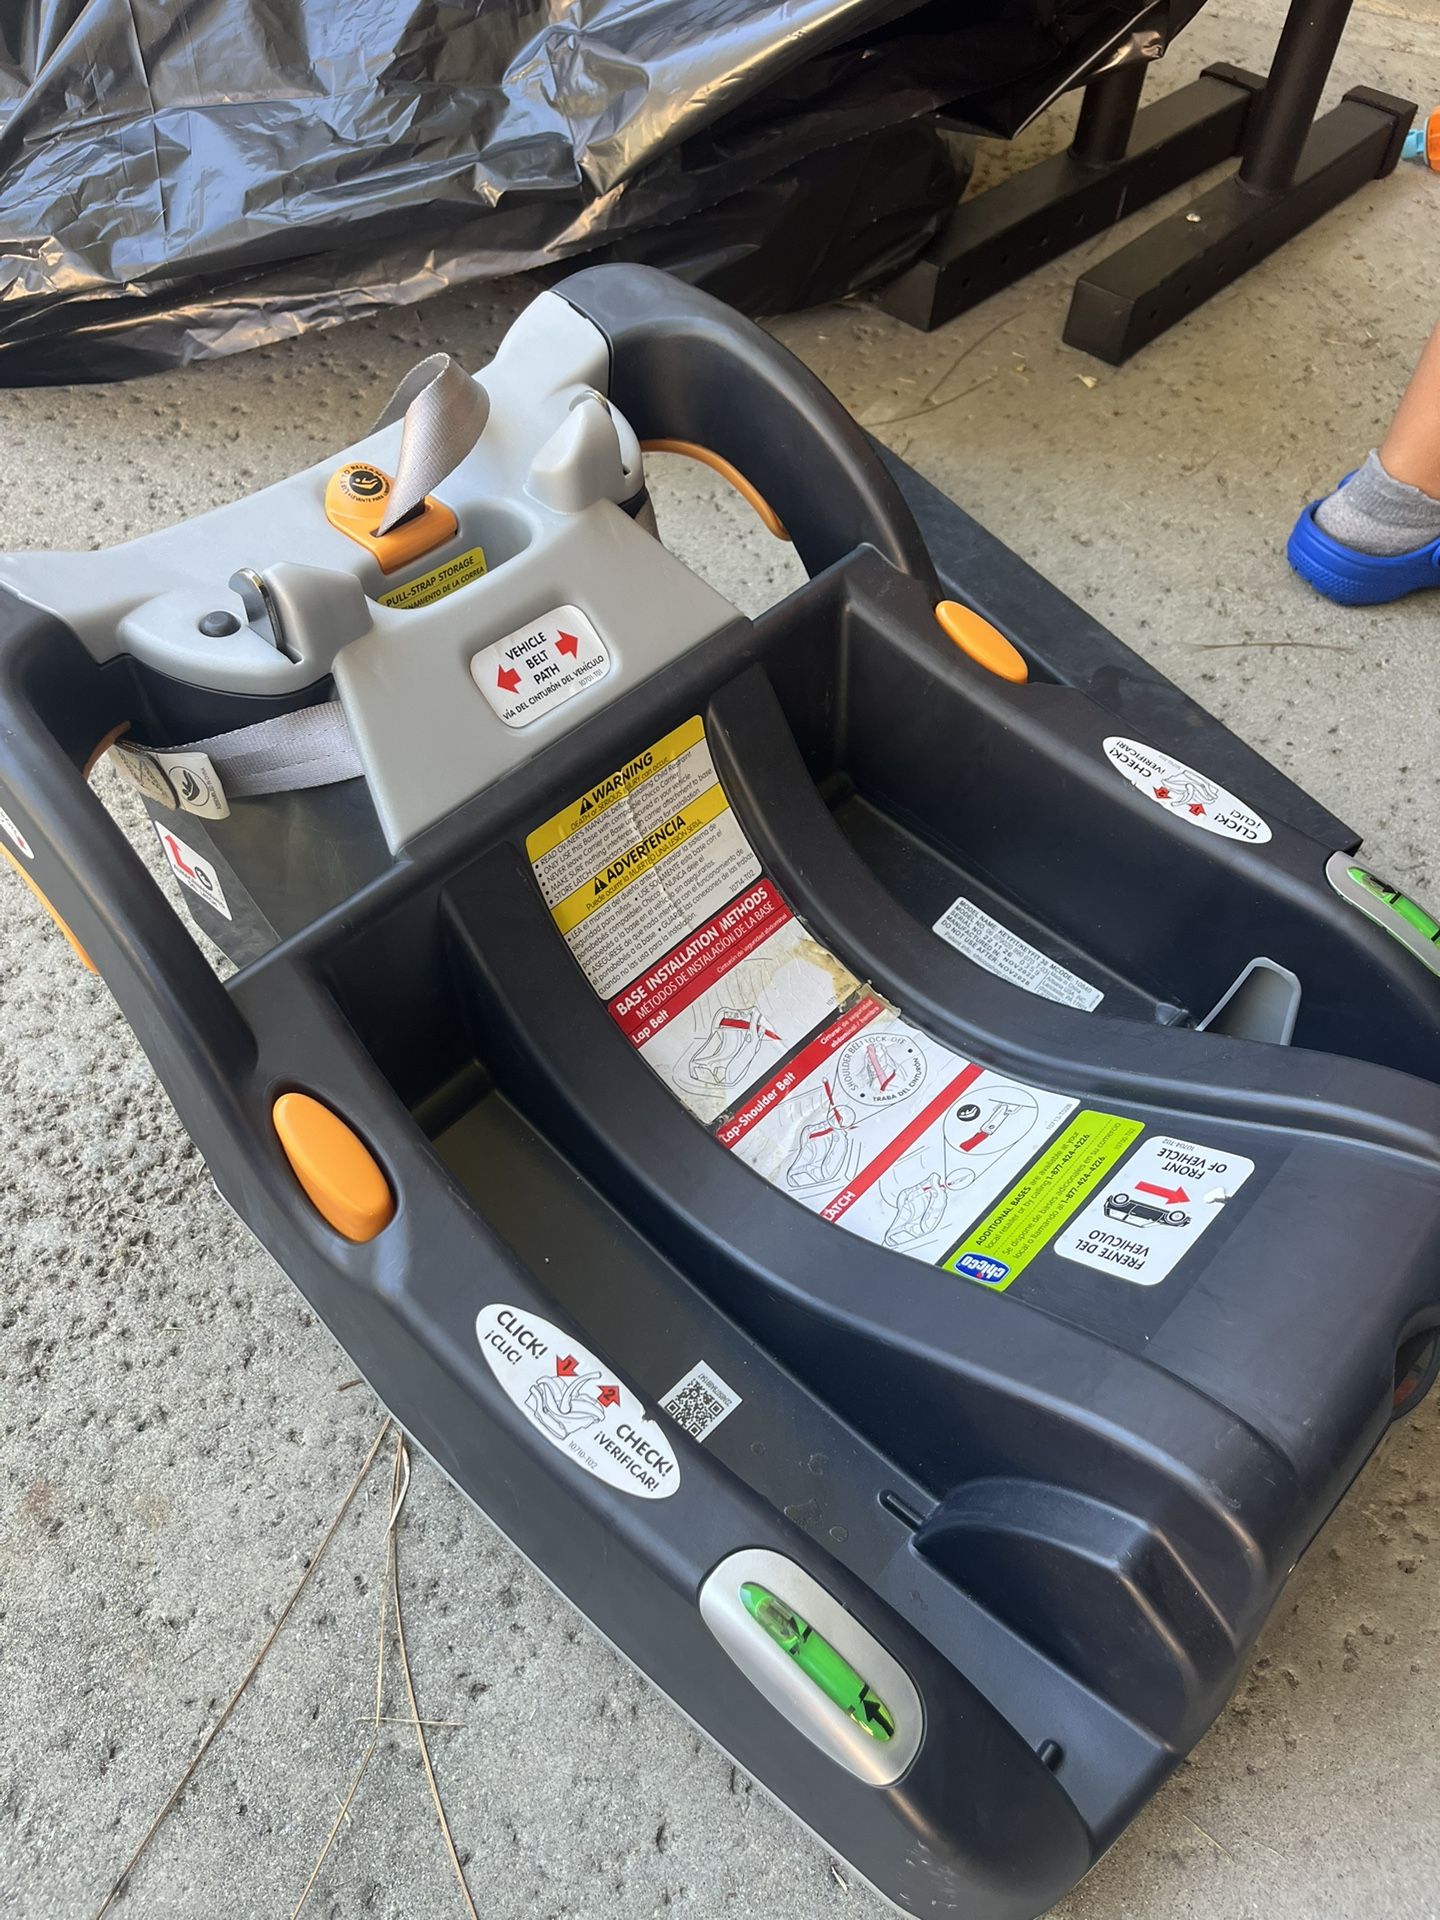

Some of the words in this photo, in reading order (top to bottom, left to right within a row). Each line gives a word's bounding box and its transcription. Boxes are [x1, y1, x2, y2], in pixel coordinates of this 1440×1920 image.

[386, 577, 436, 607] PULL-STRAP
[438, 556, 474, 582] STORAGE
[442, 584, 451, 593] DE
[452, 580, 460, 588] LA
[460, 566, 484, 583] CORREA
[505, 632, 547, 660] VEHICLE
[526, 650, 548, 669] BELT
[503, 708, 516, 720] VÍA
[516, 702, 529, 713] DEL
[528, 682, 561, 705] CINTURÓN
[561, 673, 574, 685] DEL
[573, 655, 604, 677] VEHÍCULO
[533, 663, 560, 684] PATH
[1109, 747, 1152, 778] CHECK!
[1116, 740, 1166, 775] ¡VERIFICAR!
[592, 752, 653, 800] WARNING
[570, 812, 590, 830] DEATH
[597, 789, 622, 811] SERIOUS
[1214, 812, 1258, 840] CLICK!
[1230, 810, 1262, 829] ¡CLIC!
[539, 849, 557, 866] READ
[556, 829, 584, 853] OWNER'S
[583, 810, 610, 833] MANUAL
[543, 858, 560, 874] ONLY
[559, 849, 571, 863] USE
[571, 841, 583, 854] this
[582, 830, 598, 845] Base
[597, 821, 610, 834] with
[546, 864, 566, 883] NEVER
[565, 852, 583, 869] leave
[609, 821, 625, 836] Base
[604, 813, 685, 882] ADVERTENCIA
[549, 874, 568, 892] MAKE
[568, 863, 583, 879] SURE
[583, 846, 607, 869] nothing
[553, 882, 573, 901] STORE
[572, 868, 592, 887] LATCH
[591, 845, 622, 873] connectors
[622, 832, 639, 849] when
[570, 925, 582, 939] LEA
[581, 920, 589, 930] el
[587, 903, 611, 925] manual
[610, 895, 621, 907] del
[639, 869, 655, 886] antes
[708, 821, 716, 832] de
[665, 868, 687, 889] NUNCA
[637, 885, 650, 899] USE
[958, 900, 980, 917] MODEL
[600, 914, 616, 930] para
[608, 903, 643, 937] compatibles
[617, 929, 625, 939] la
[624, 917, 640, 935] base
[647, 906, 654, 916] el
[949, 909, 972, 928] SERIAL
[954, 904, 976, 922] MODEL
[622, 935, 632, 948] de
[631, 927, 644, 943] que
[642, 914, 659, 932] nada
[634, 941, 642, 951] la
[940, 919, 952, 929] DO
[950, 926, 964, 938] NOT
[963, 936, 977, 948] USE
[945, 914, 993, 951] MANUFACTURED
[597, 972, 620, 995] cuando
[620, 966, 629, 977] no
[628, 958, 638, 970] las
[637, 950, 649, 963] usa
[649, 939, 663, 955] para
[615, 984, 648, 1016] BASE
[645, 925, 720, 992] INSTALLATION
[717, 885, 768, 932] METHODS
[634, 979, 678, 1020] MÉTODOS
[674, 970, 689, 987] DE
[732, 922, 747, 938] DE
[743, 914, 757, 929] LA
[753, 899, 774, 921] BASE
[631, 1023, 653, 1046] Lap
[649, 1007, 670, 1030] Belt
[842, 1054, 858, 1091] SHOULDER
[720, 1088, 778, 1143] Lap-Shoulder
[775, 1072, 796, 1092] Belt
[873, 1094, 897, 1102] TRABA
[898, 1088, 910, 1096] DEL
[1155, 1147, 1208, 1168] VEHICLE
[1160, 1160, 1206, 1179] FRONT
[1207, 1161, 1229, 1173] OF
[824, 1190, 856, 1221] LATCH
[974, 1206, 1013, 1245] ADDITIONAL
[1009, 1185, 1031, 1206] BASES
[1071, 1238, 1099, 1254] DEL
[1085, 1228, 1152, 1259] VEHÍCULO
[1097, 1247, 1146, 1270] FRENTE
[961, 1256, 1006, 1279] chicco
[484, 1330, 523, 1365] ¡CLIC!
[497, 1310, 548, 1360] CLICK!
[594, 1430, 660, 1492] ¡VERIFICAR!
[615, 1423, 674, 1478] CHECK!
